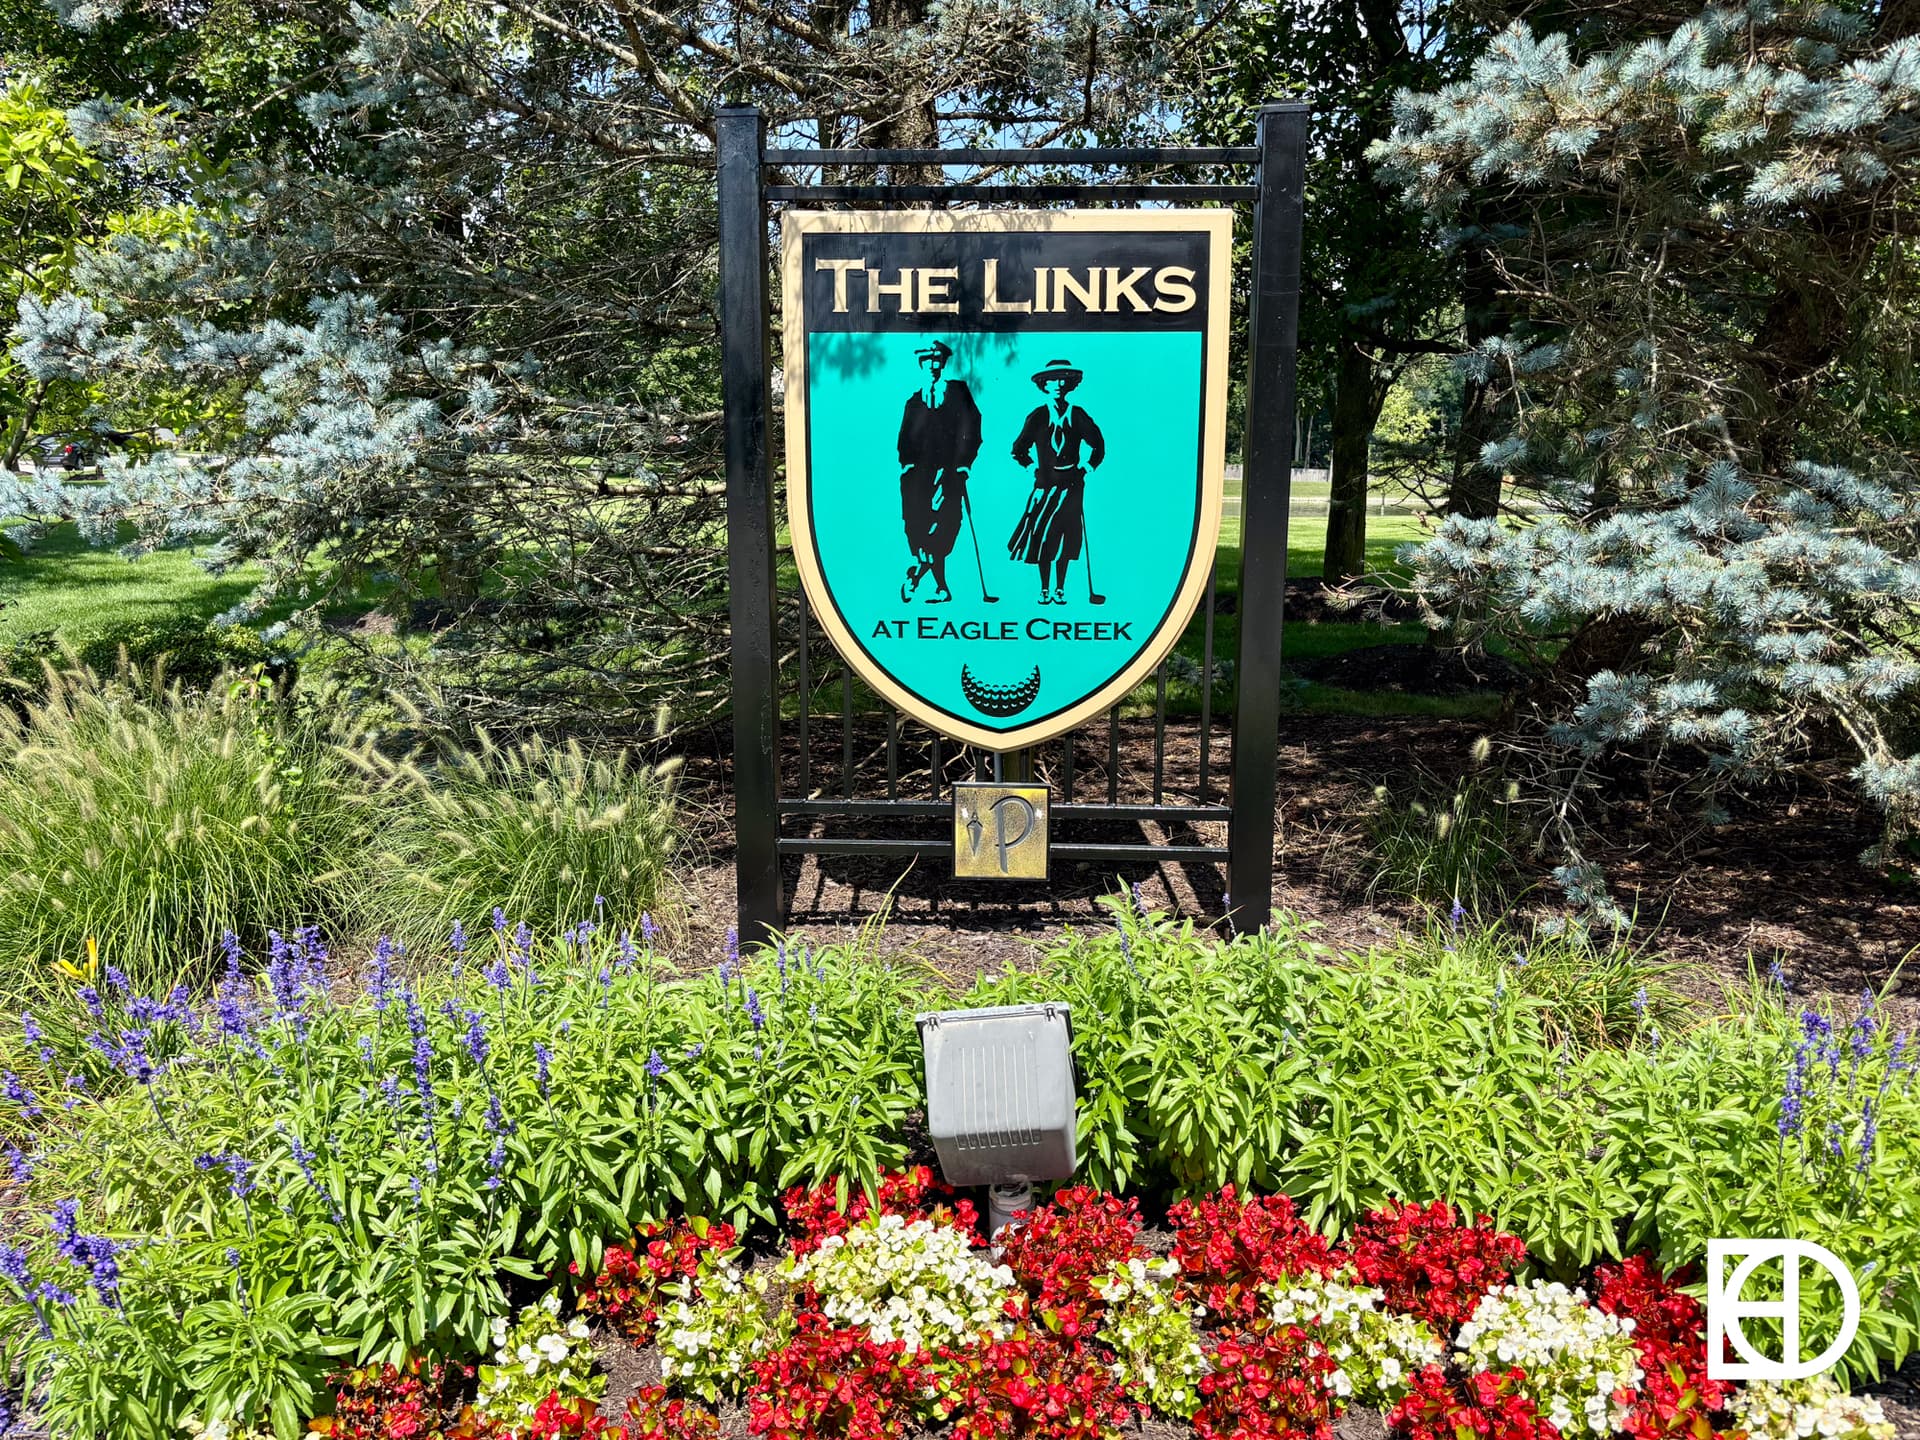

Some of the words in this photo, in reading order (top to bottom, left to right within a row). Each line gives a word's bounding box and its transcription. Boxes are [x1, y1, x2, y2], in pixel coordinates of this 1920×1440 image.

[815, 257, 960, 314] THE
[982, 257, 1197, 315] LINKS
[872, 620, 910, 639] AT
[916, 616, 1019, 640] EAGLE
[1025, 617, 1133, 641] CREEK
[988, 795, 1035, 874] P
